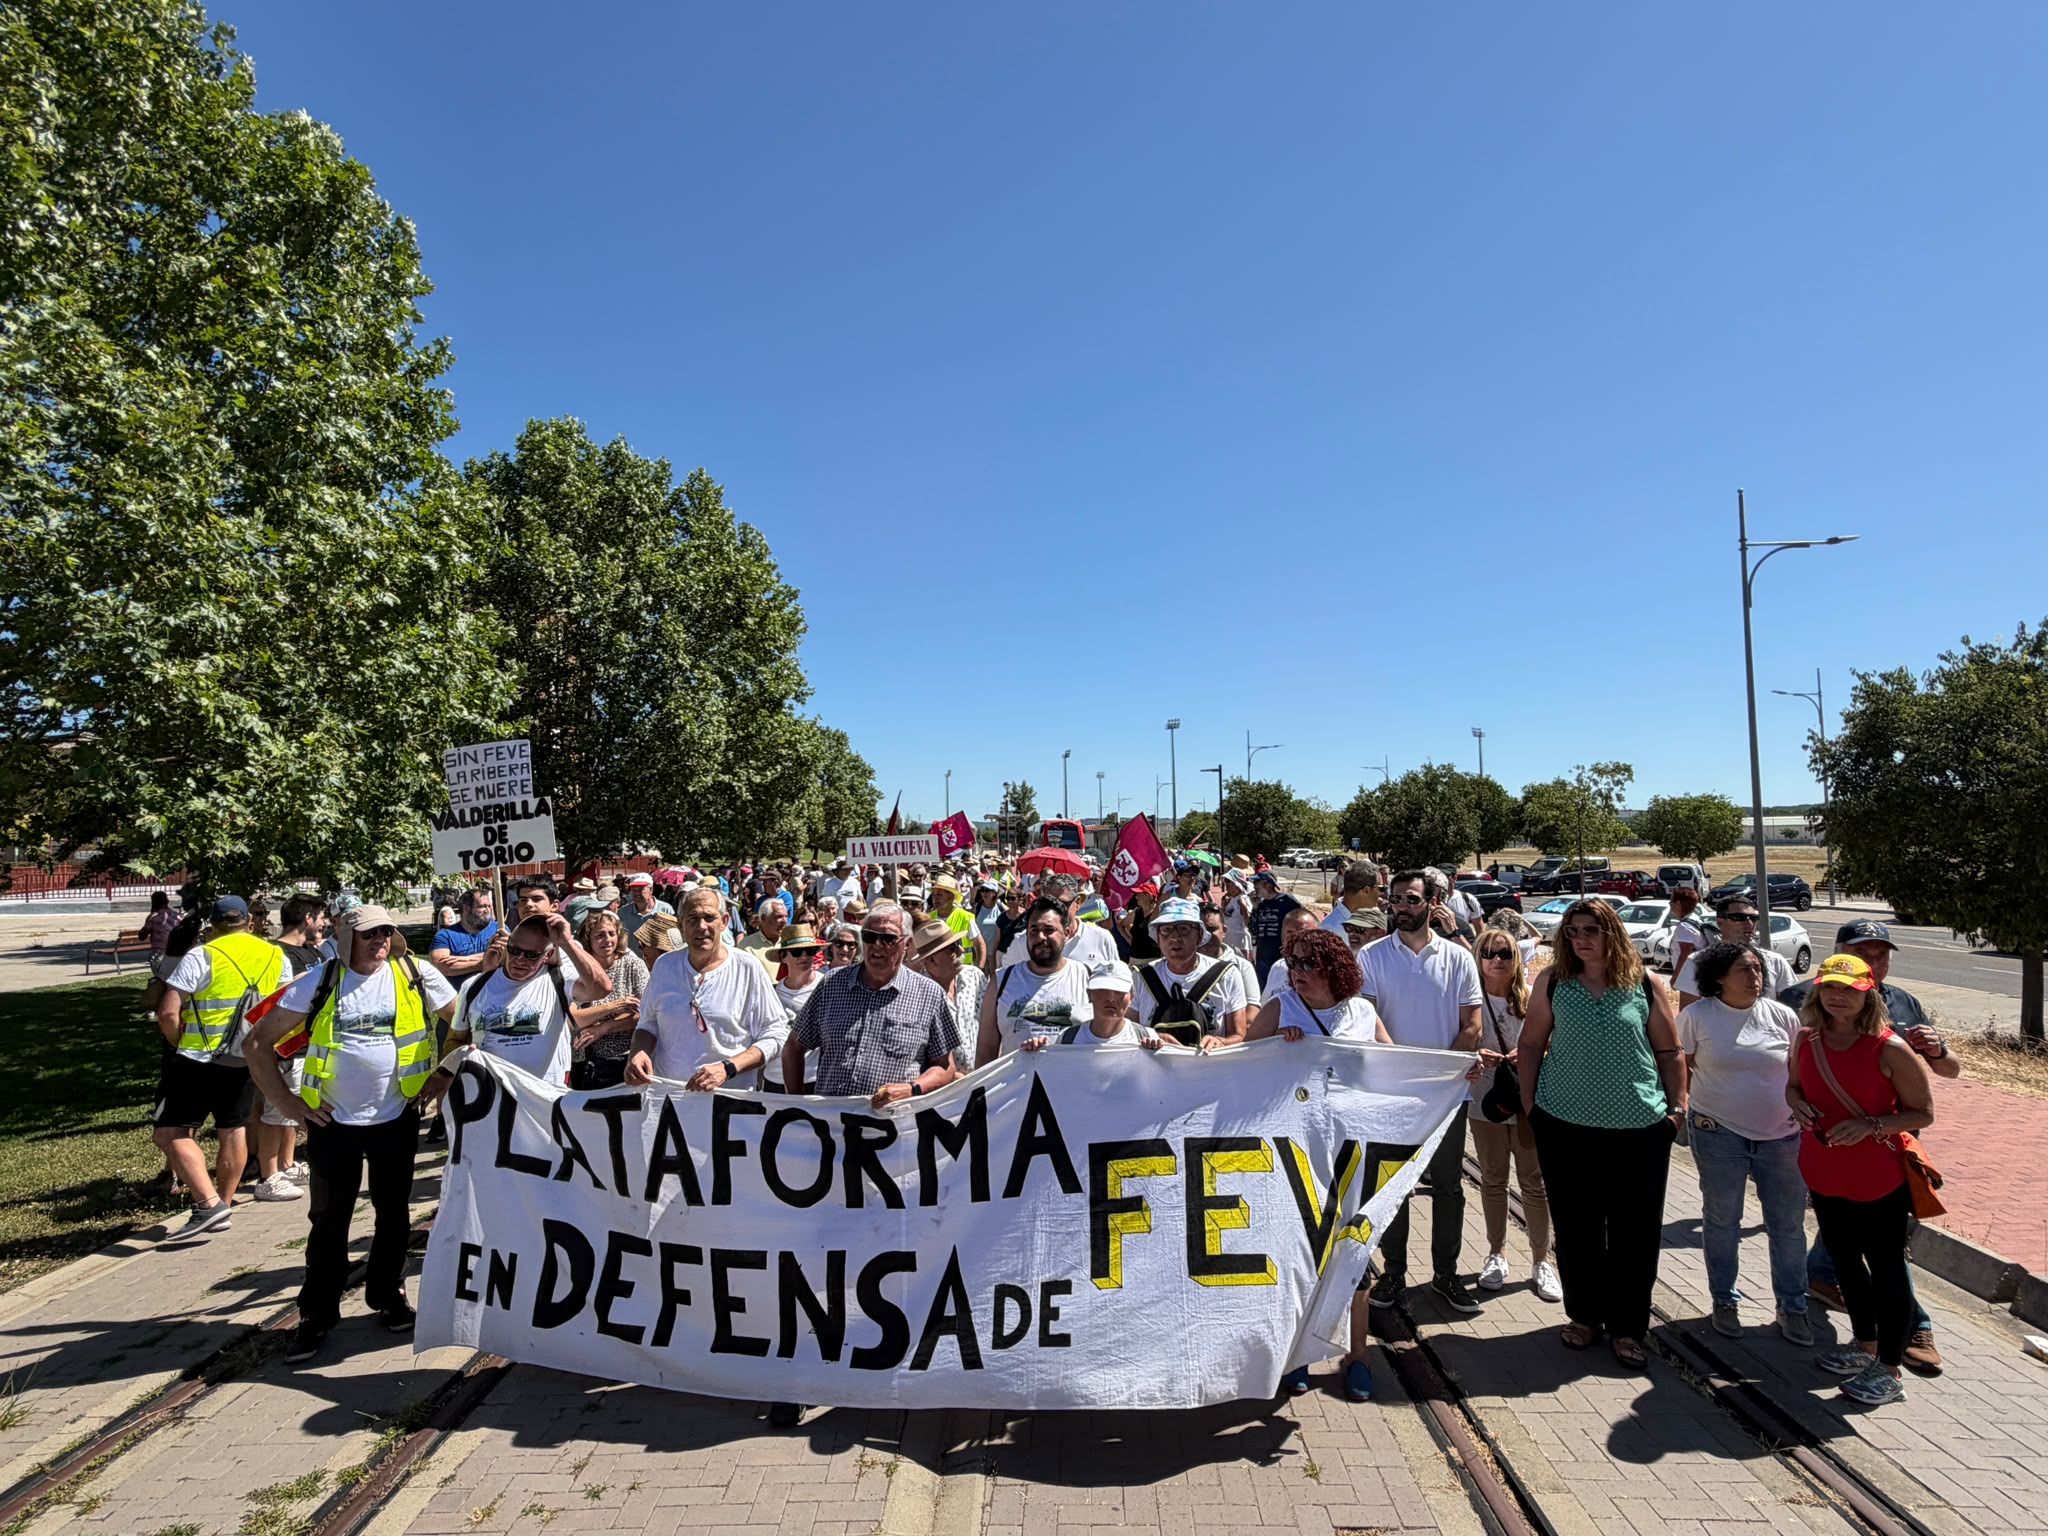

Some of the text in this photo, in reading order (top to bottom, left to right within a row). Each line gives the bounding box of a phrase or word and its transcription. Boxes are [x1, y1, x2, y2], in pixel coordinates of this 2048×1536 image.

[445, 743, 529, 768] SIN FEVE
[447, 771, 467, 786] LA
[450, 779, 532, 805] SE MUERE
[430, 798, 551, 831] VALDERILLA
[483, 824, 509, 846] DE
[458, 842, 535, 870] TORIO
[851, 840, 932, 858] LA VALCUEVA
[449, 1060, 1084, 1209] PLATAFORMA
[455, 1218, 1073, 1371] EN DEFENSA DE
